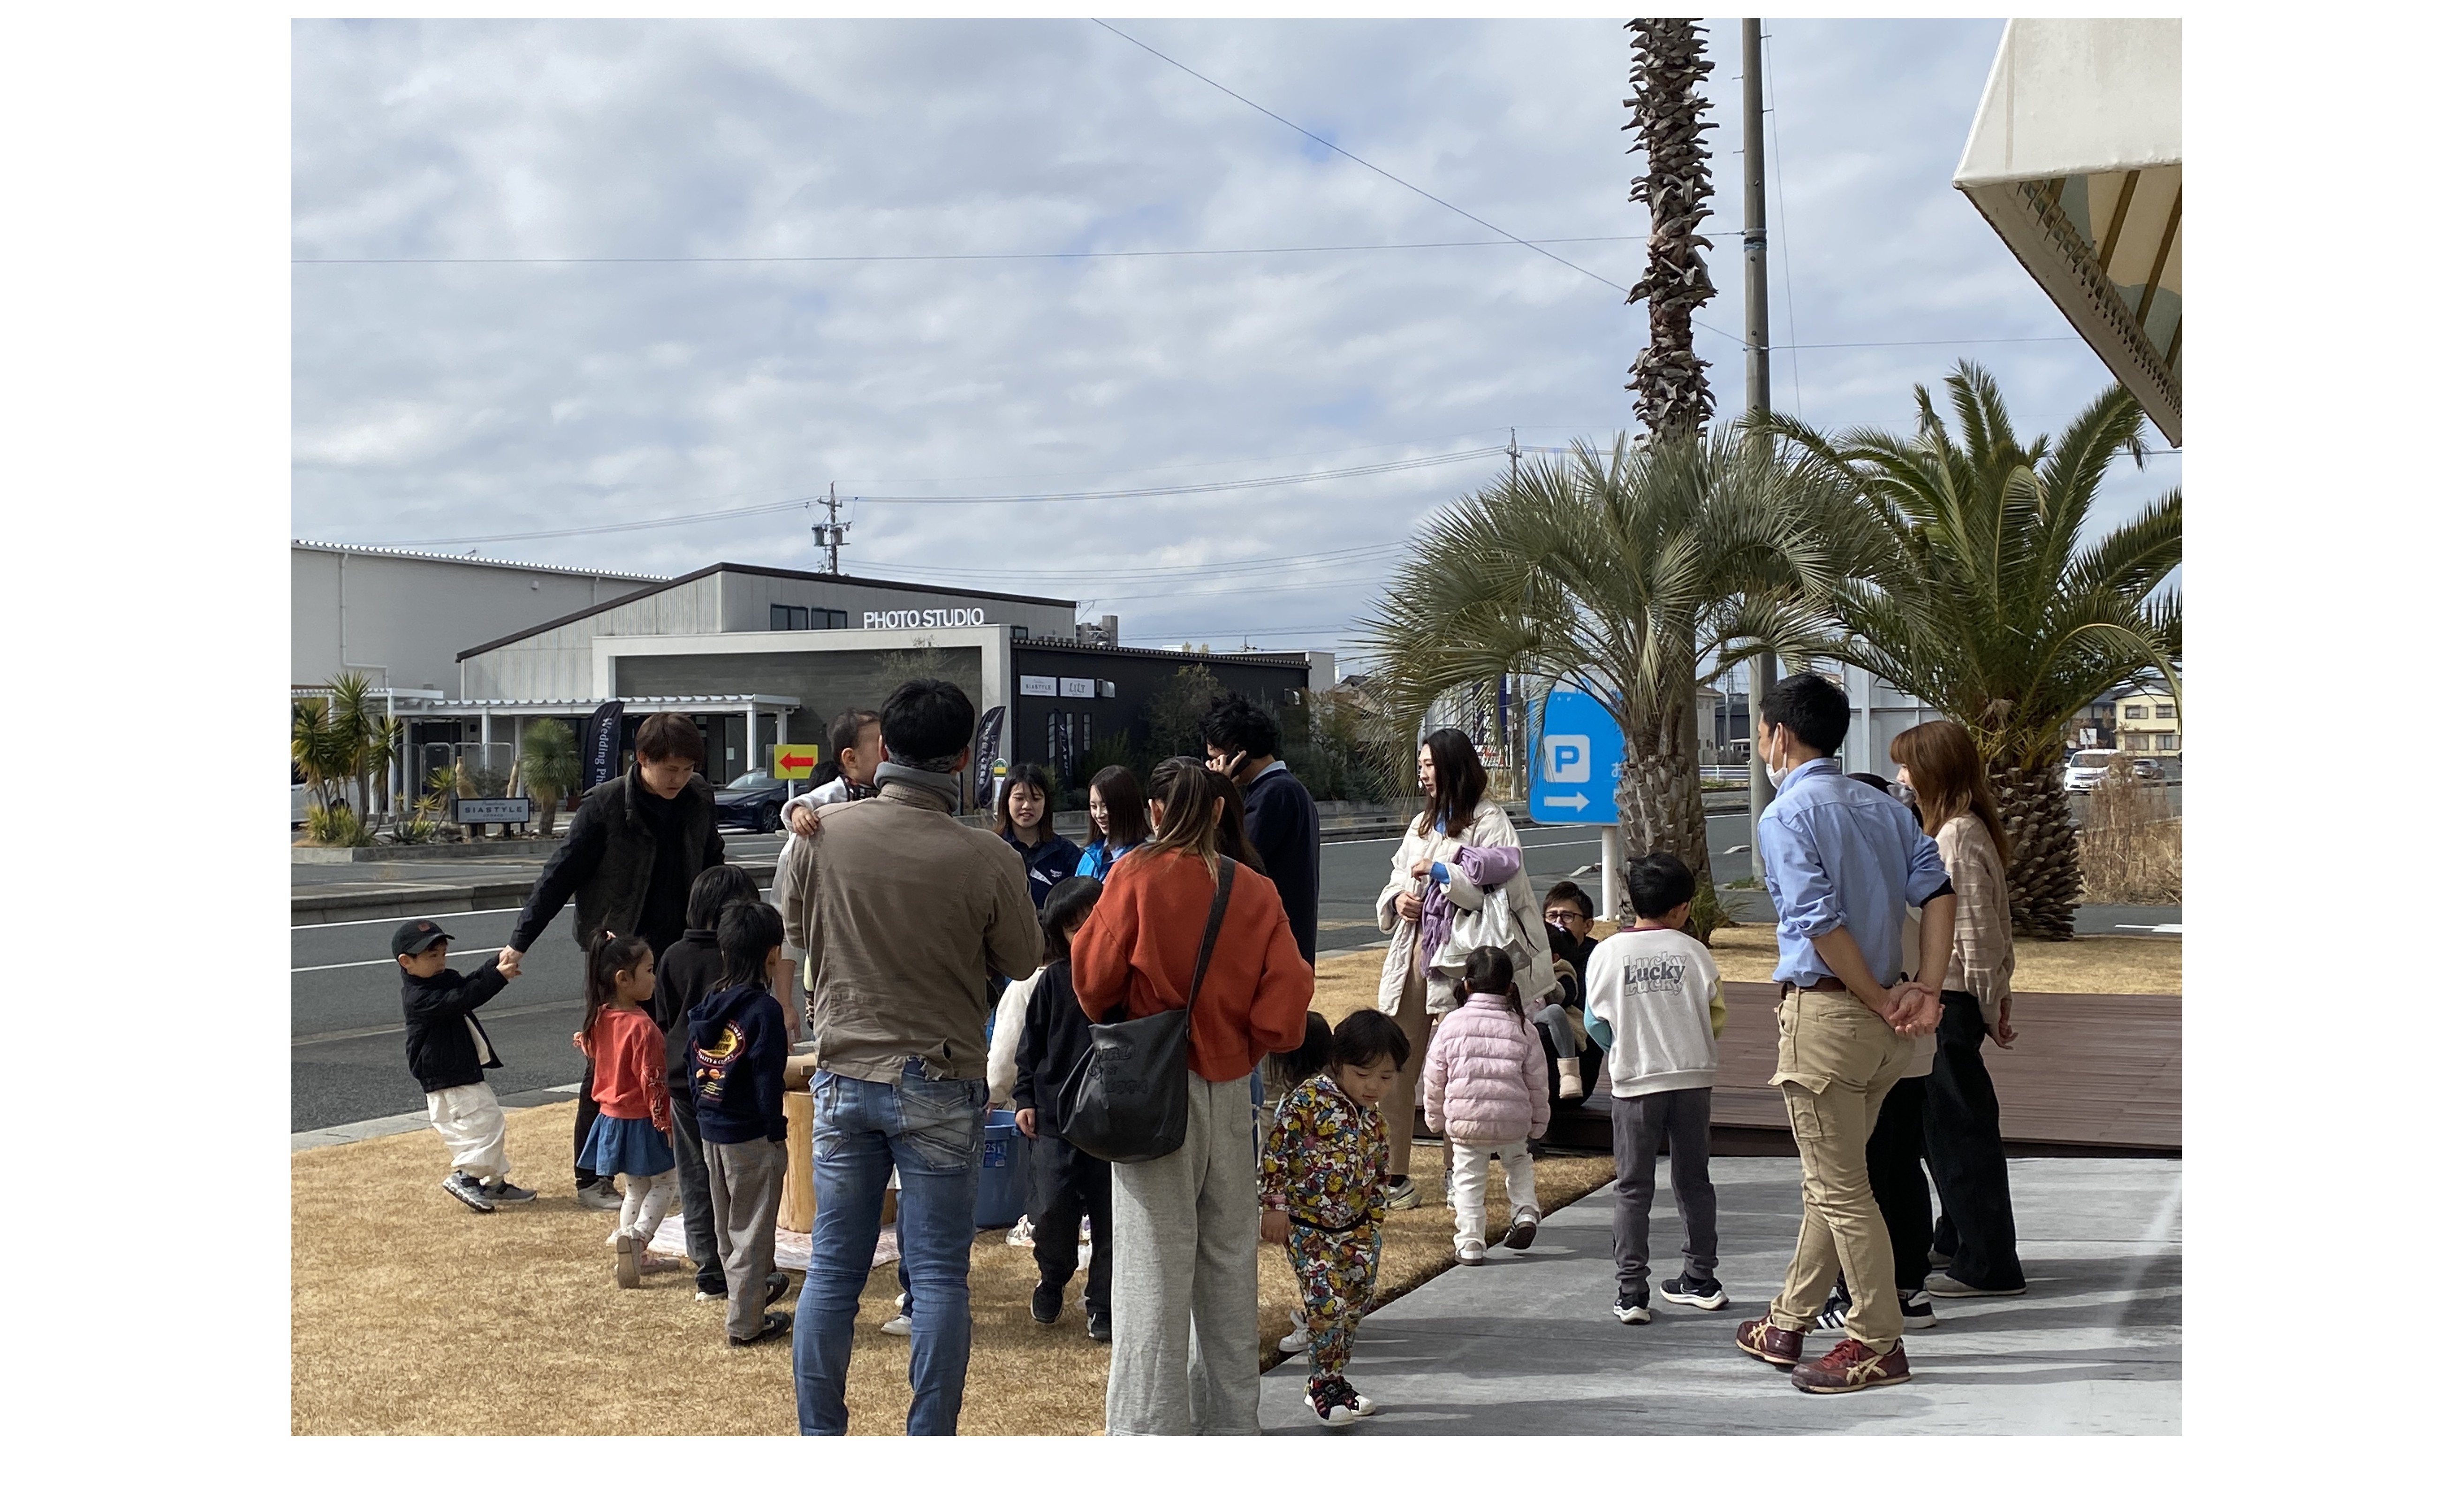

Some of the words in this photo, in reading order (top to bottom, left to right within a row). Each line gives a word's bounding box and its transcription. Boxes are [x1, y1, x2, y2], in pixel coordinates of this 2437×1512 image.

[864, 610, 920, 629] PHOTO
[922, 608, 985, 627] STUDIO
[594, 717, 613, 765] Wedding
[1555, 745, 1580, 773] P
[1624, 962, 1685, 985] Lucky
